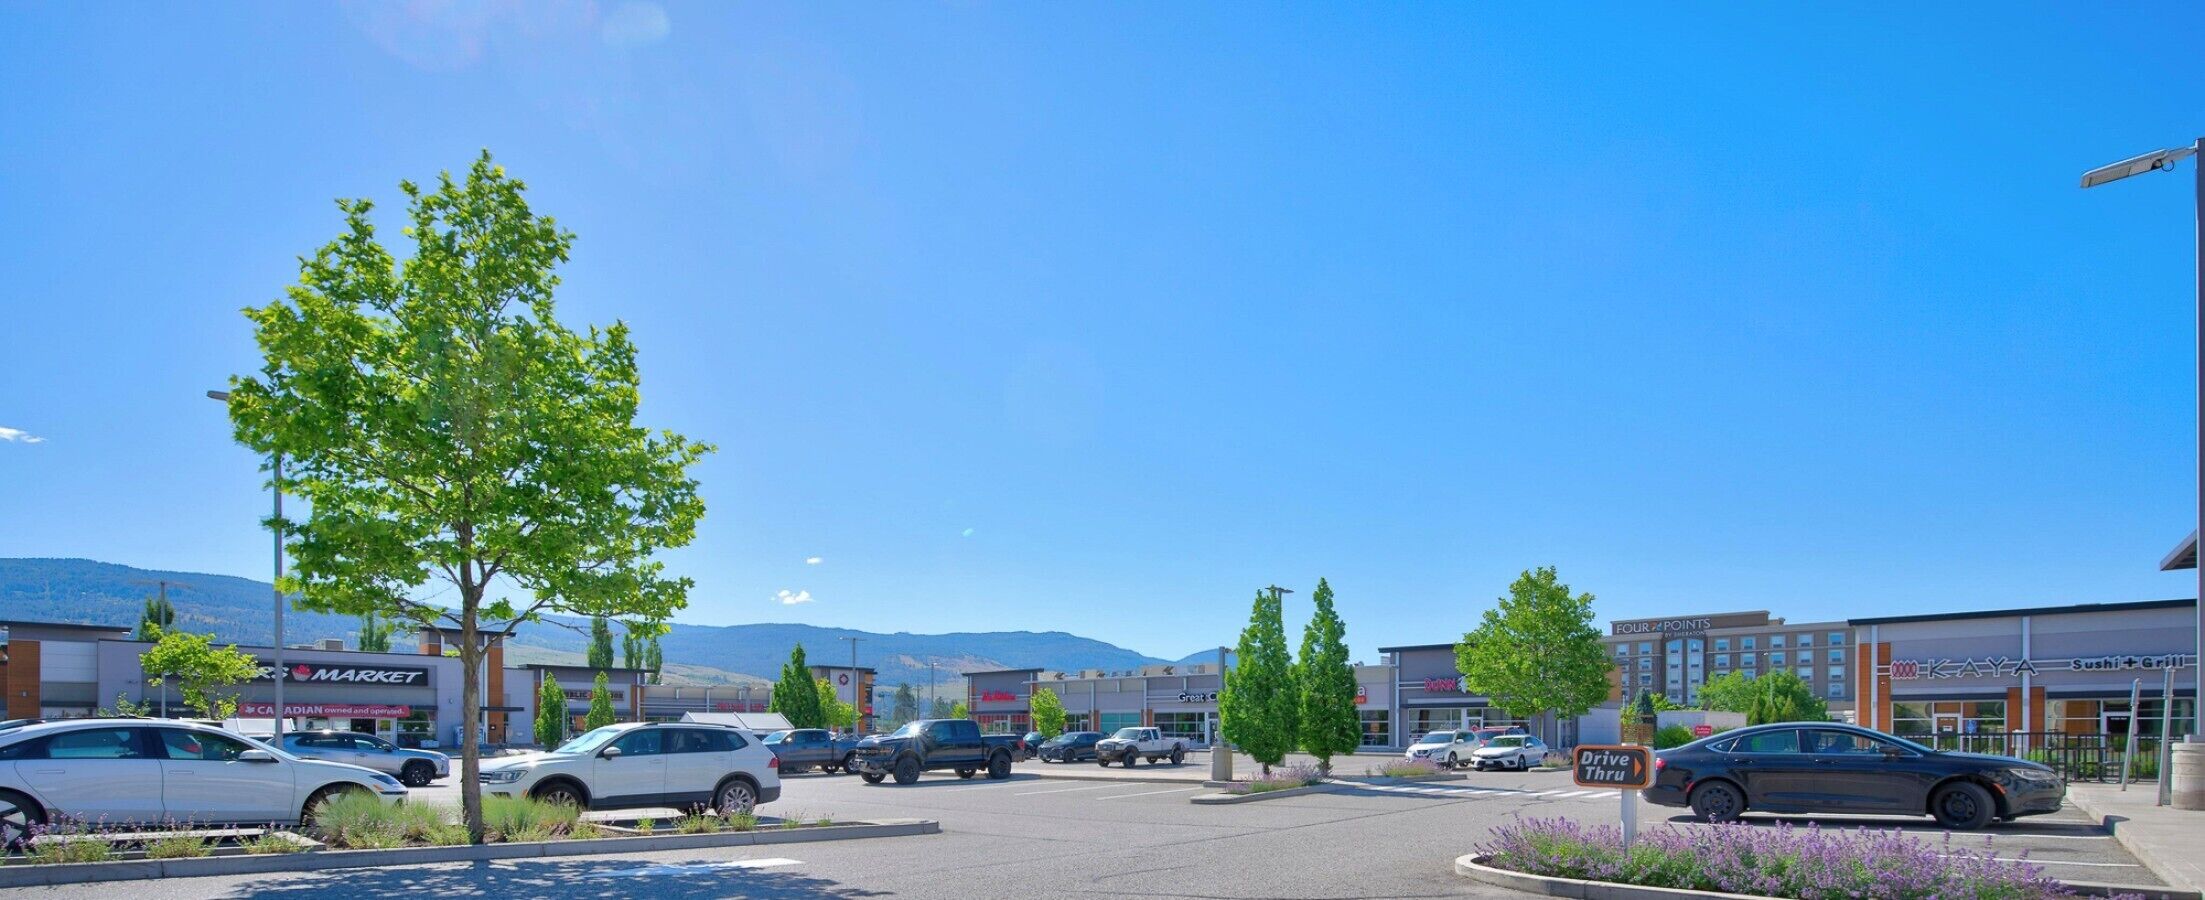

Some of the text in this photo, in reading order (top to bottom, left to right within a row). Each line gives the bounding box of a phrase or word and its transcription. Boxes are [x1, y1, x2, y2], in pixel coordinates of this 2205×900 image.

[1616, 618, 1711, 634] FOUR POINTS
[1927, 656, 2039, 679] KAYA
[2071, 656, 2120, 671] Sushi
[2141, 655, 2185, 669] Grill
[310, 668, 423, 684] MARKET
[1178, 692, 1206, 703] Great
[257, 705, 323, 715] CAADIAN
[1581, 750, 1630, 766] Drive
[1585, 766, 1626, 781] Thru
